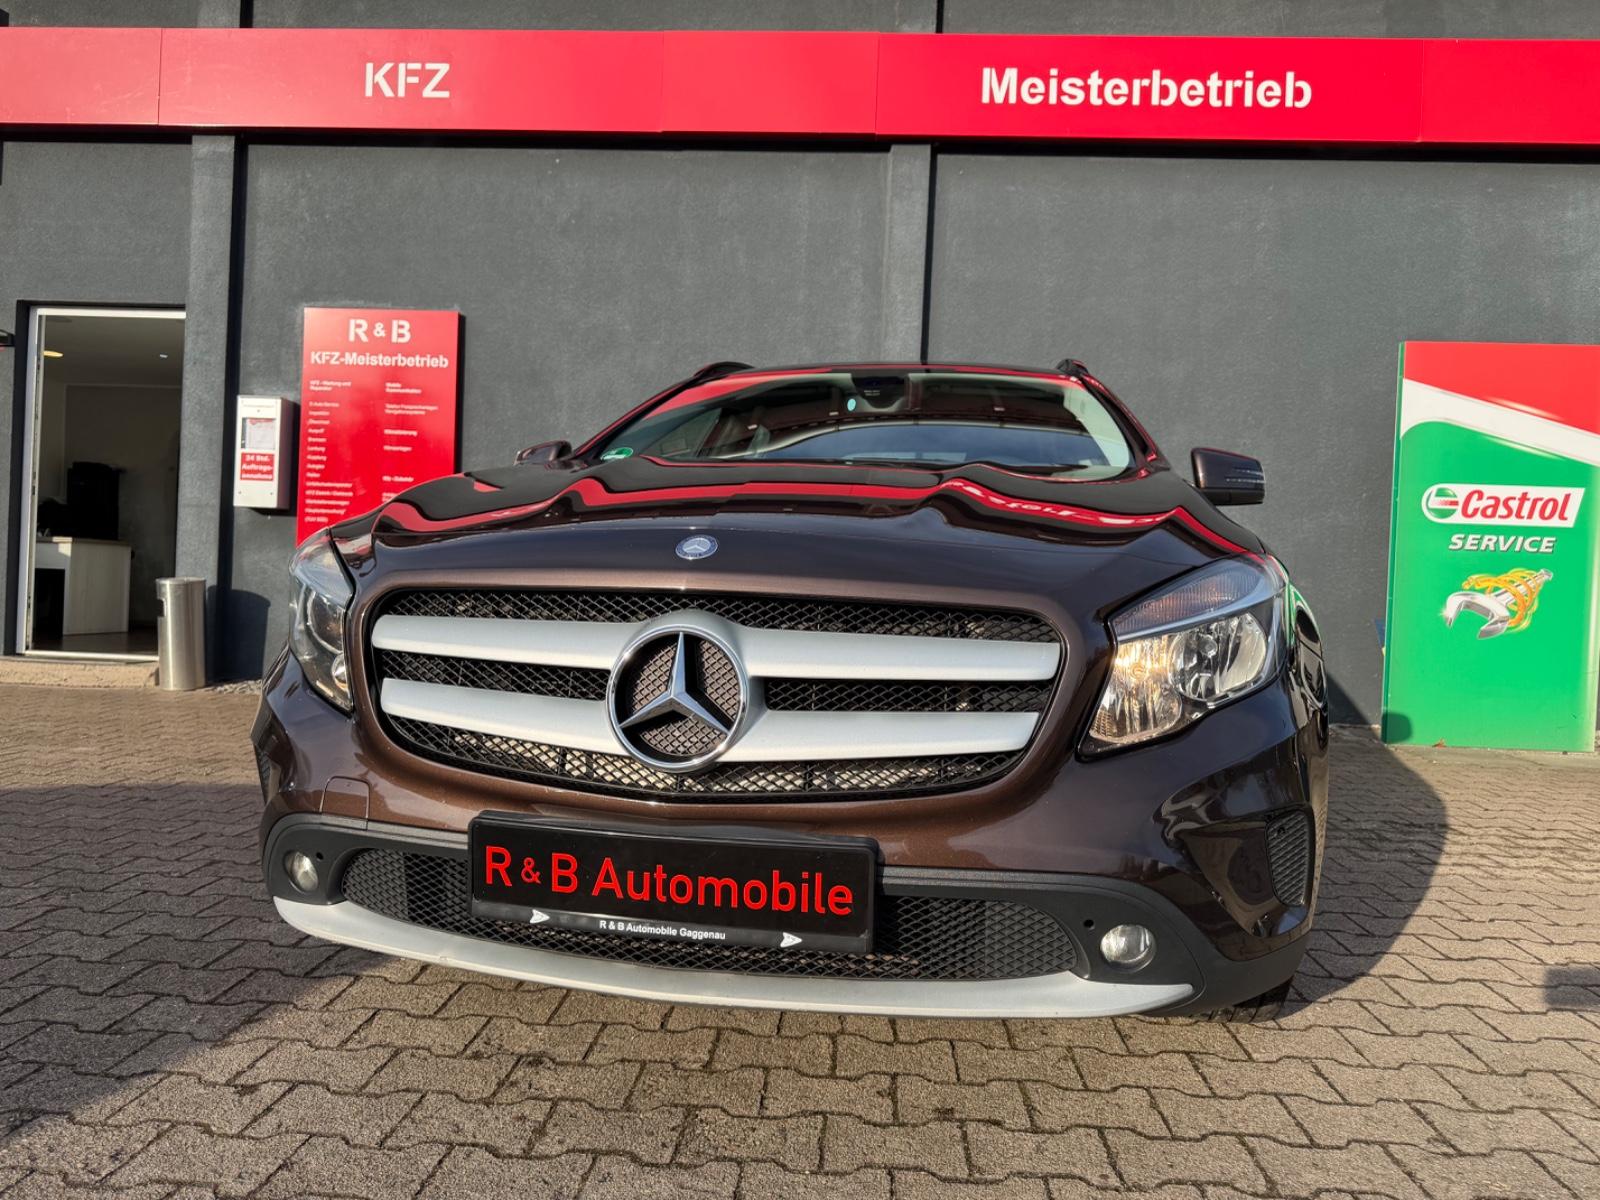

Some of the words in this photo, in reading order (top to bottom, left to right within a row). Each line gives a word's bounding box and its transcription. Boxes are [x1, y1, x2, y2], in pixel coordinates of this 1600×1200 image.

[365, 62, 450, 98] KFZ
[981, 67, 1312, 108] Meisterbetrieb
[348, 319, 369, 342] R
[373, 322, 386, 337] &
[391, 319, 411, 343] B
[310, 351, 449, 368] KFZ-Meisterbetrieb
[1461, 489, 1571, 521] Castrol
[1449, 534, 1556, 553] SERVICE
[485, 846, 512, 887] R
[520, 857, 541, 884] &
[551, 853, 579, 893] B
[592, 857, 853, 915] Automobile
[600, 920, 606, 929] R
[608, 921, 615, 930] &
[617, 922, 624, 931] B
[626, 923, 677, 936] Automobile
[680, 927, 726, 940] Gaggenau
